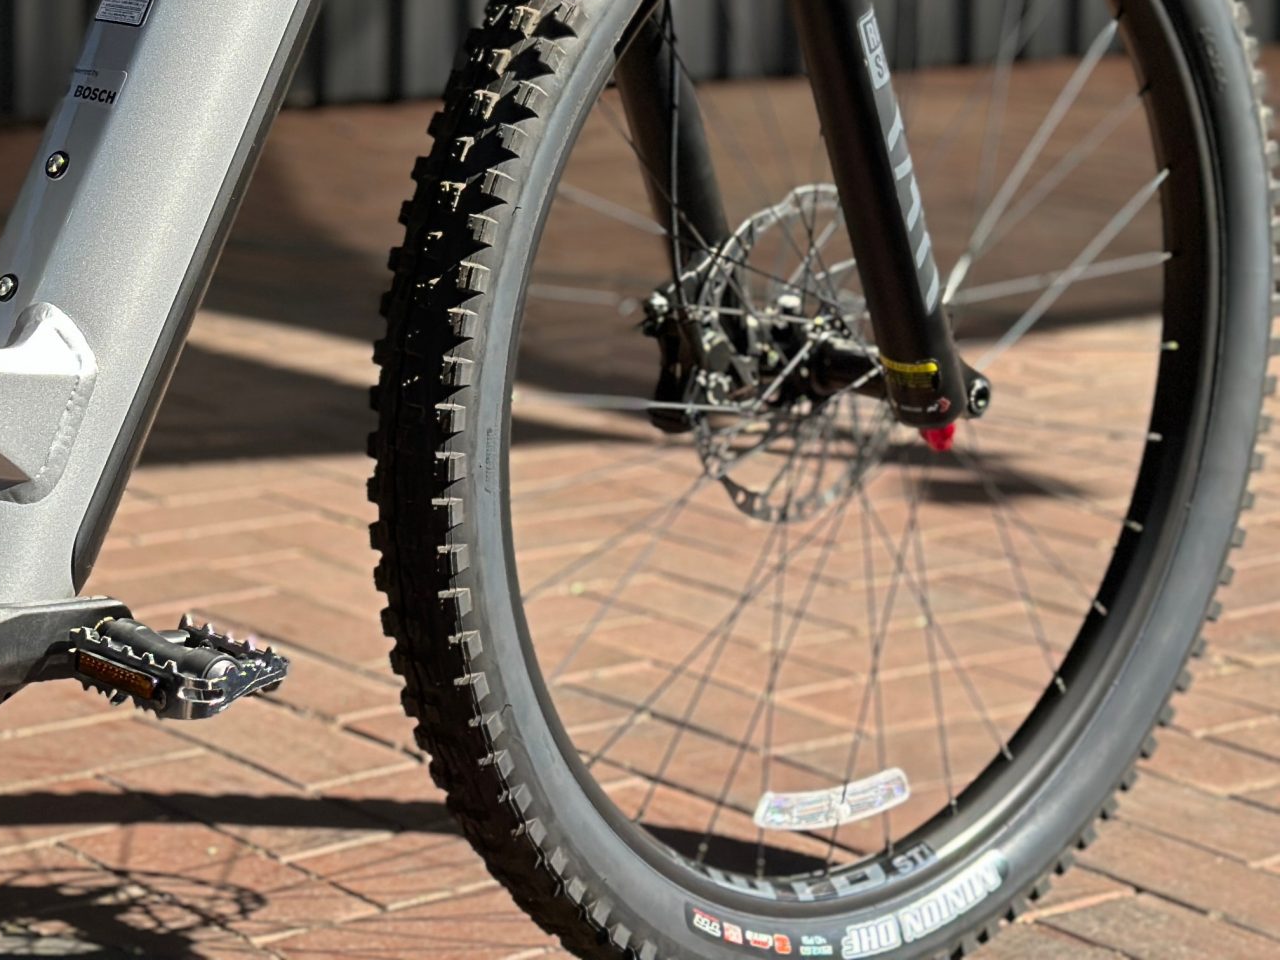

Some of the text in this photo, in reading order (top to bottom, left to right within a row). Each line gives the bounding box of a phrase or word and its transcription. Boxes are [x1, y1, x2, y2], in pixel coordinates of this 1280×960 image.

[73, 84, 117, 105] BOSCH
[841, 848, 1004, 959] MINION DHF
